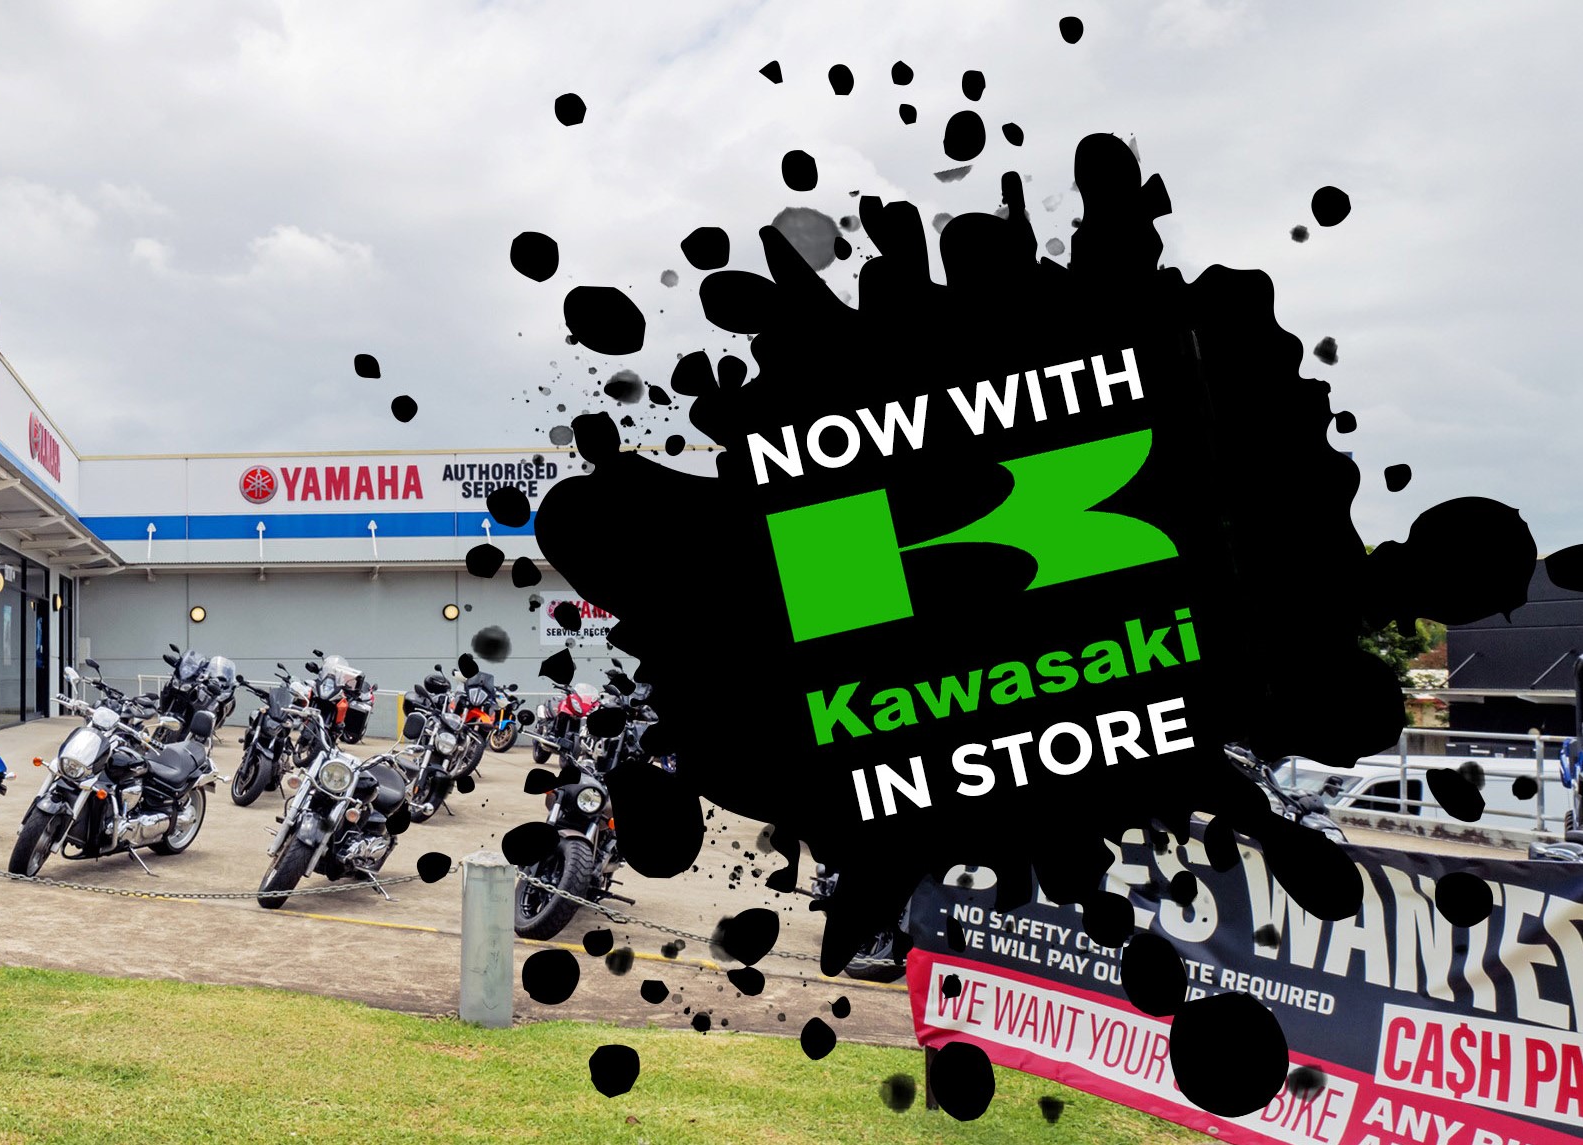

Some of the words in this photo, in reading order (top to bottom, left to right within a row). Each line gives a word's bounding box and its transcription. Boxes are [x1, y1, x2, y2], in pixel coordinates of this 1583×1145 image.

[280, 465, 424, 501] YAMAHA
[442, 462, 558, 481] AUTHORISED
[954, 904, 984, 926] NO
[989, 911, 1072, 946] SAFETY
[990, 934, 1042, 965] WILL
[1046, 949, 1090, 976] PAY
[1219, 966, 1336, 1016] REQUIRED
[994, 986, 1085, 1053] WANT
[1087, 1013, 1170, 1086] YOUR
[1383, 1016, 1512, 1104] CA$H
